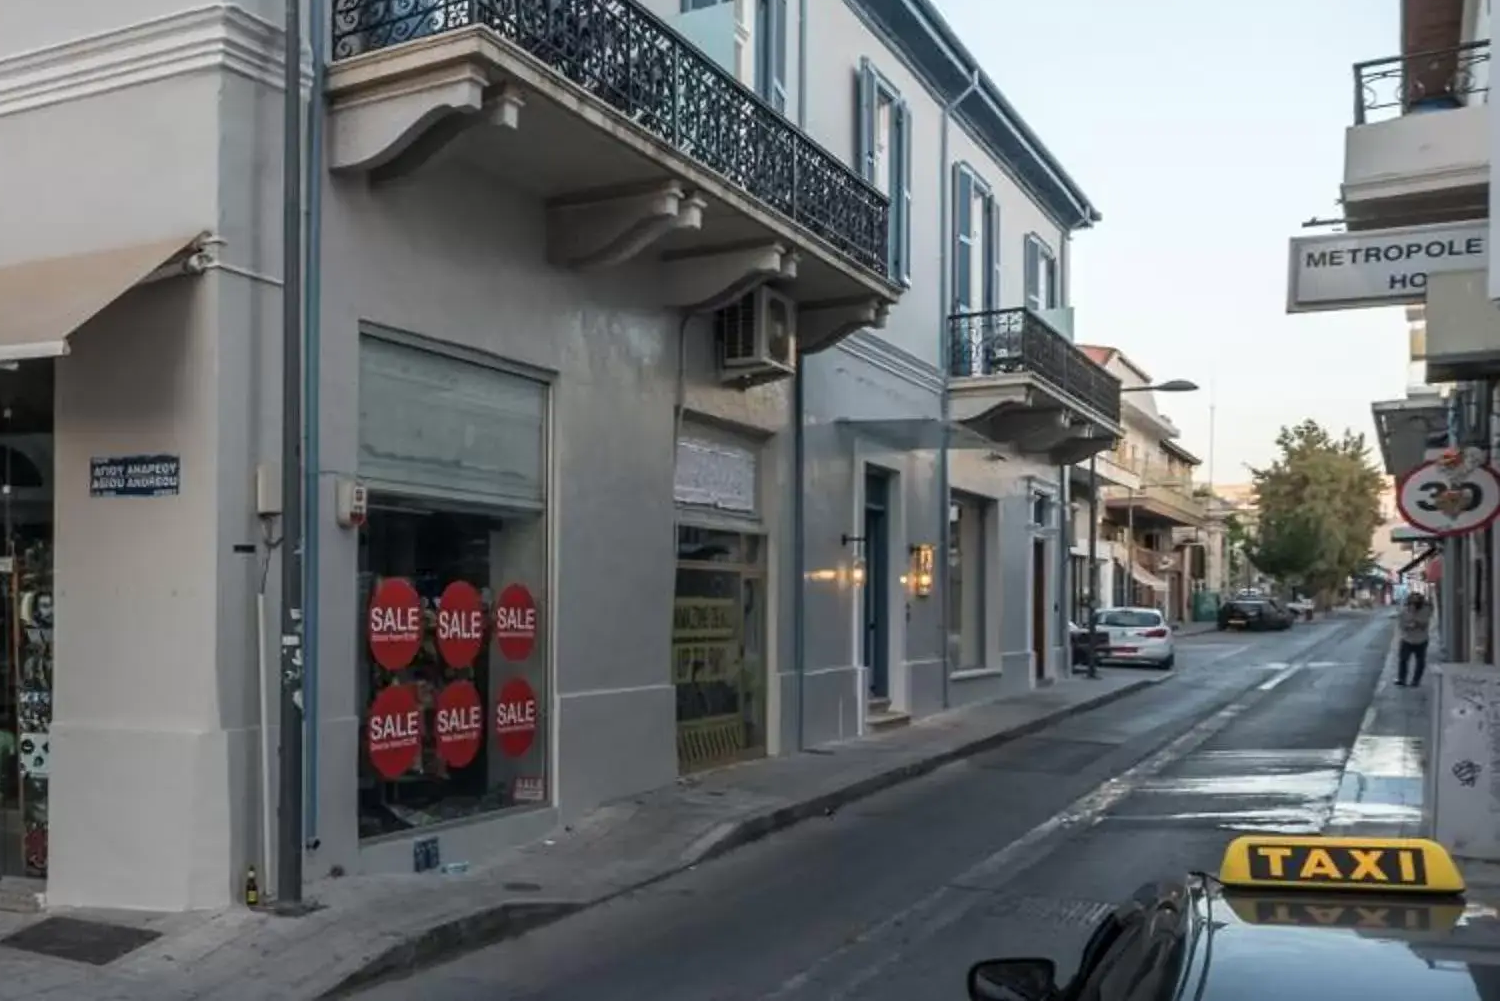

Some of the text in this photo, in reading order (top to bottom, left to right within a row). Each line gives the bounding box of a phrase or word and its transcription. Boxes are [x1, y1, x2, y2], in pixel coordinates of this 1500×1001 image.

[1306, 238, 1484, 268] METROPOLE
[371, 607, 420, 632] SALE
[439, 611, 481, 639] SALE
[497, 607, 536, 630] SALE
[371, 711, 419, 741] SALE
[437, 706, 481, 733] SALE
[496, 700, 535, 725] SALE
[1257, 847, 1416, 882] TAXI
